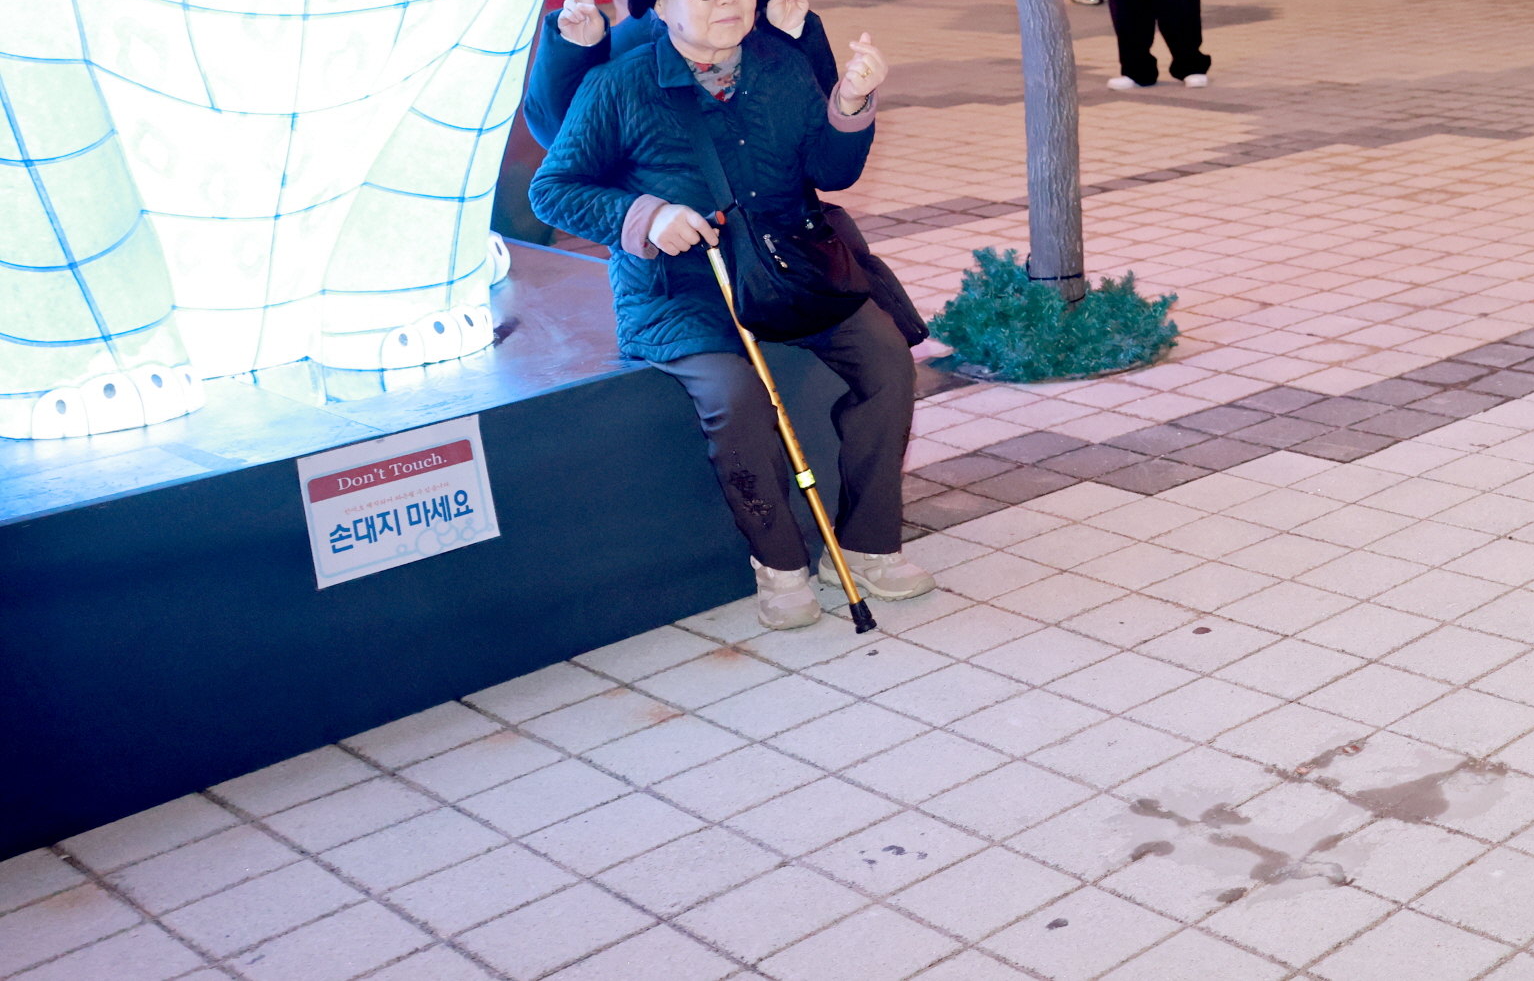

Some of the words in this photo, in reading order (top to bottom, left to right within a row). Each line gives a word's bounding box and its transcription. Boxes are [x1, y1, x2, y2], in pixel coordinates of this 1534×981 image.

[337, 468, 387, 491] Don't
[388, 452, 448, 477] Touch.
[329, 508, 402, 554] 손대지
[405, 489, 474, 527] 마세요
